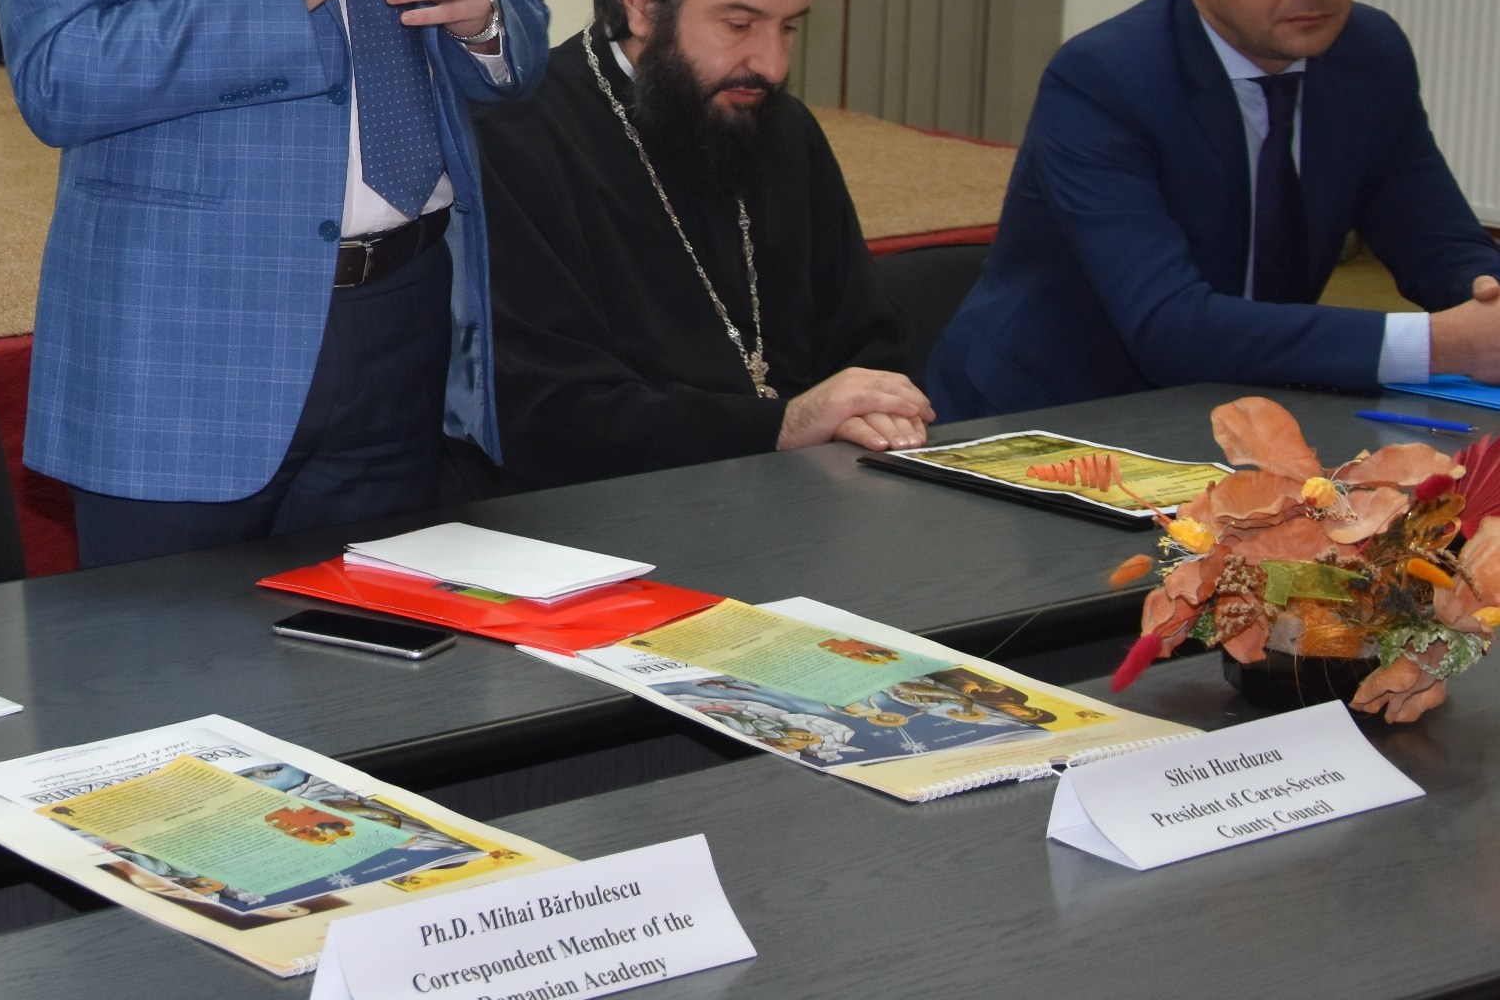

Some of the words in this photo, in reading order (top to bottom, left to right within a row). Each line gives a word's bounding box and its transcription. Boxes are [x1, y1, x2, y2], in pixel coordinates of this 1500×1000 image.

[196, 747, 252, 763] Foa
[1164, 764, 1210, 787] Silviu
[1207, 749, 1283, 776] Hurduzeu
[1150, 798, 1226, 827] President
[1225, 791, 1243, 808] of
[1272, 800, 1335, 824] Council
[420, 917, 475, 947] Ph.D.
[478, 901, 535, 933] Mihai
[538, 880, 642, 919] Bărbulescu
[412, 944, 558, 994] Correspondent
[558, 926, 637, 958] Member
[642, 916, 662, 938] of
[663, 912, 694, 933] the
[477, 980, 579, 1000] omanian
[584, 957, 668, 991] Academy
